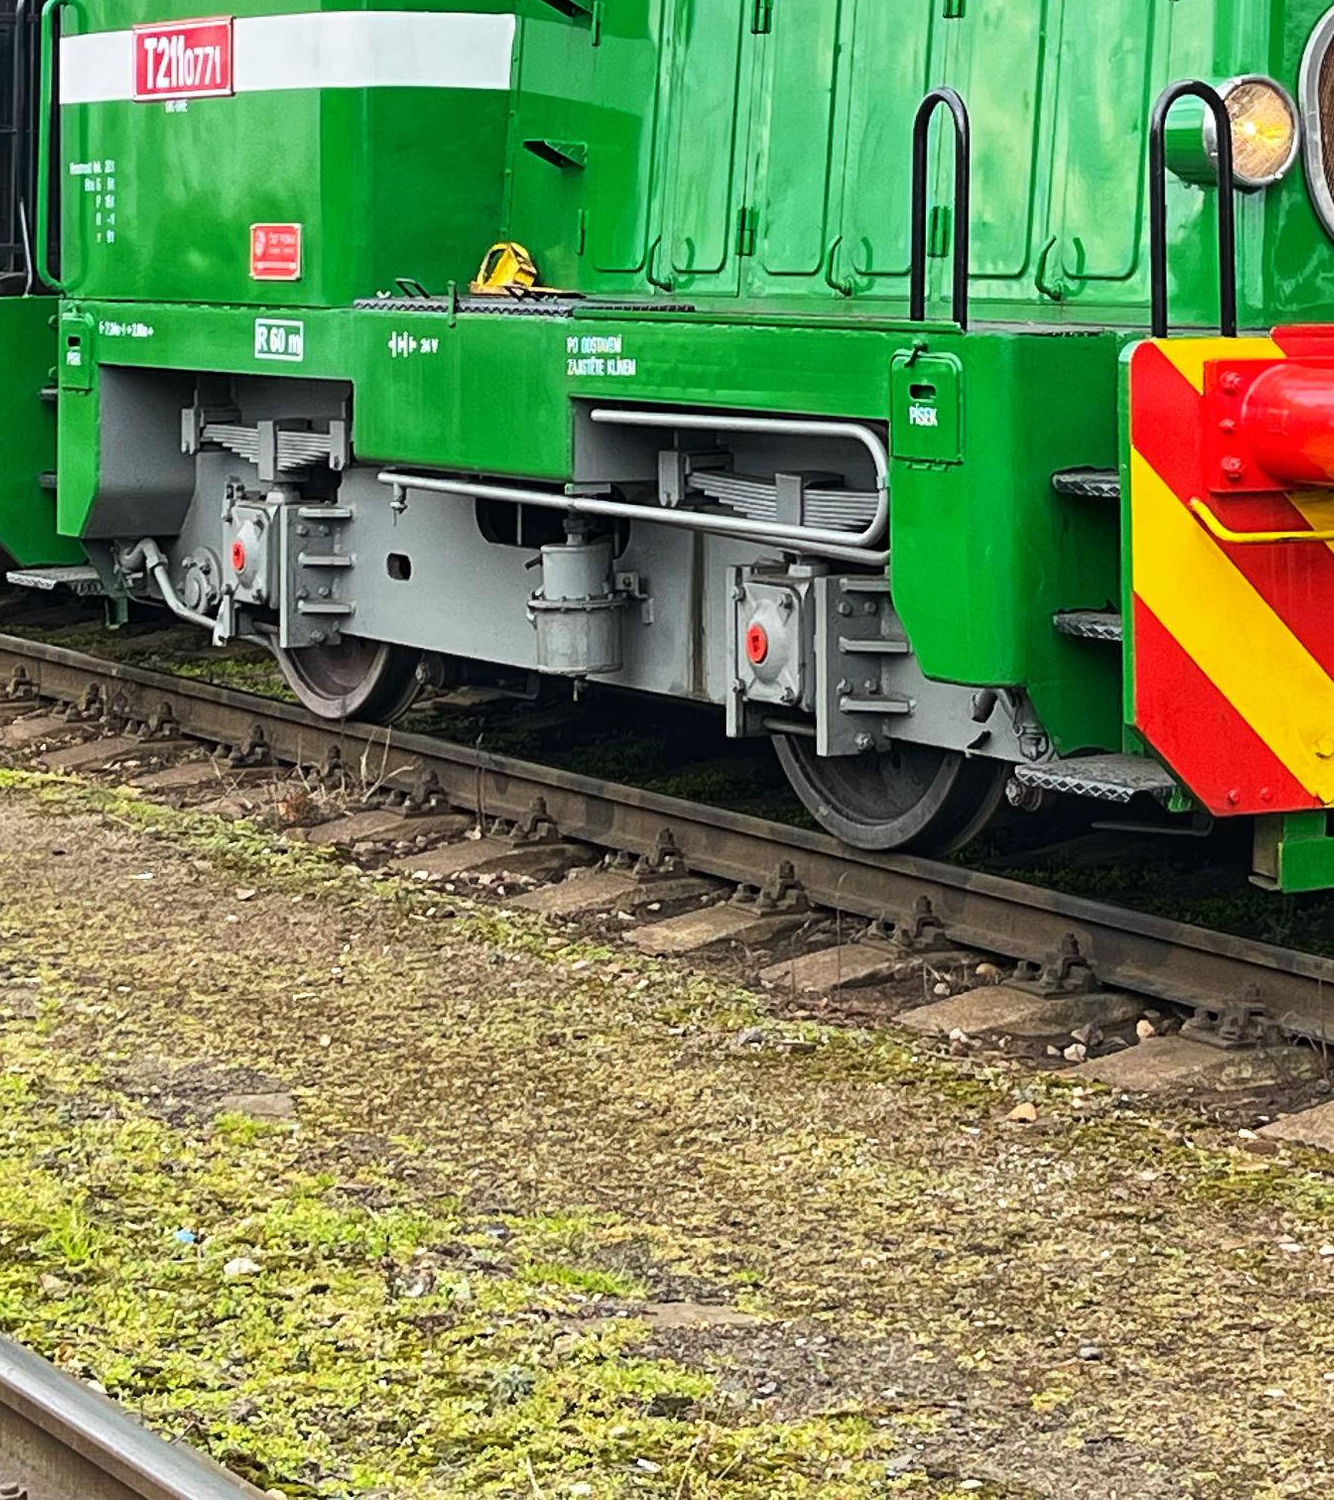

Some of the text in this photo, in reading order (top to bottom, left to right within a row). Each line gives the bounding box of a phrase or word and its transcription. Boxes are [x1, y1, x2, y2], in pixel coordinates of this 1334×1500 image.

[257, 325, 301, 355] R 60 m
[908, 402, 938, 427] PÍSEK
